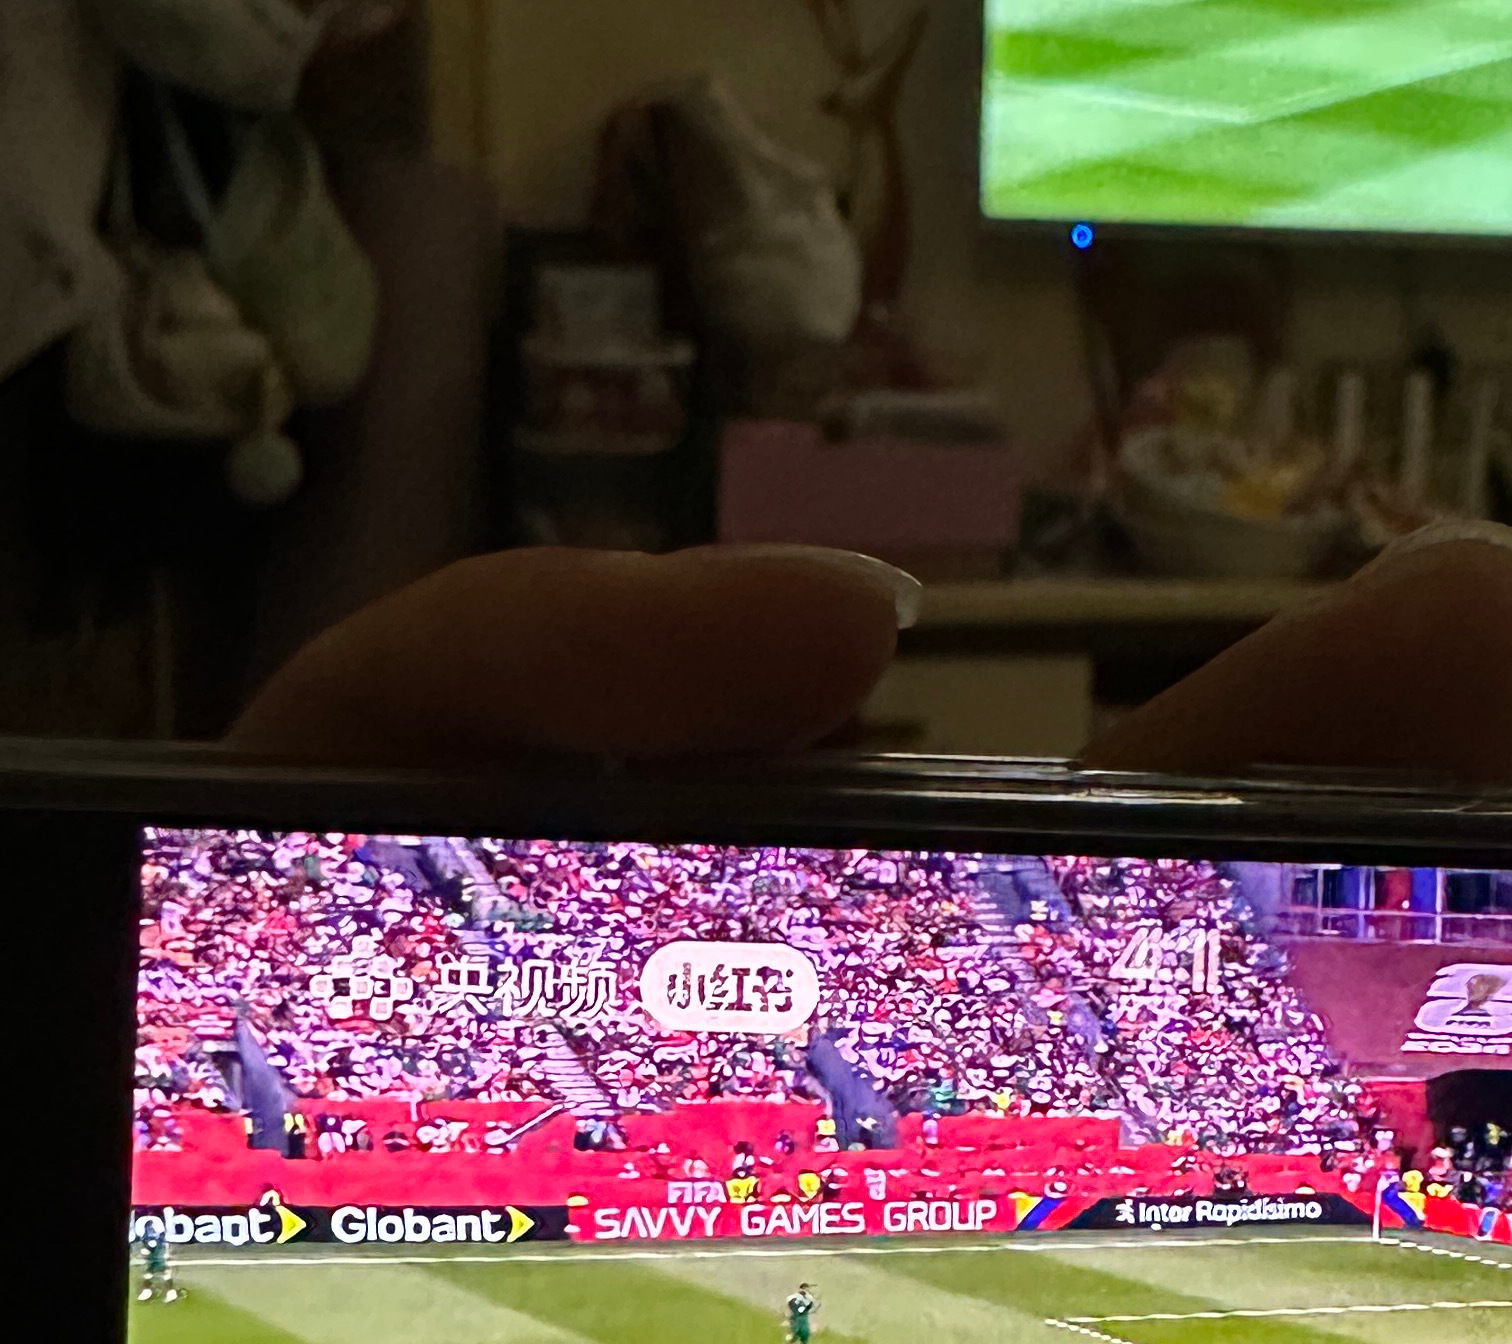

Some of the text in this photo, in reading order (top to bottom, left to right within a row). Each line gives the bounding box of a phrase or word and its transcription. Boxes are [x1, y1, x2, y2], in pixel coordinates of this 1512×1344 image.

[129, 1207, 275, 1246] obant
[330, 1206, 506, 1244] Globant
[594, 1199, 998, 1240] SAVVY GAMES GROUP
